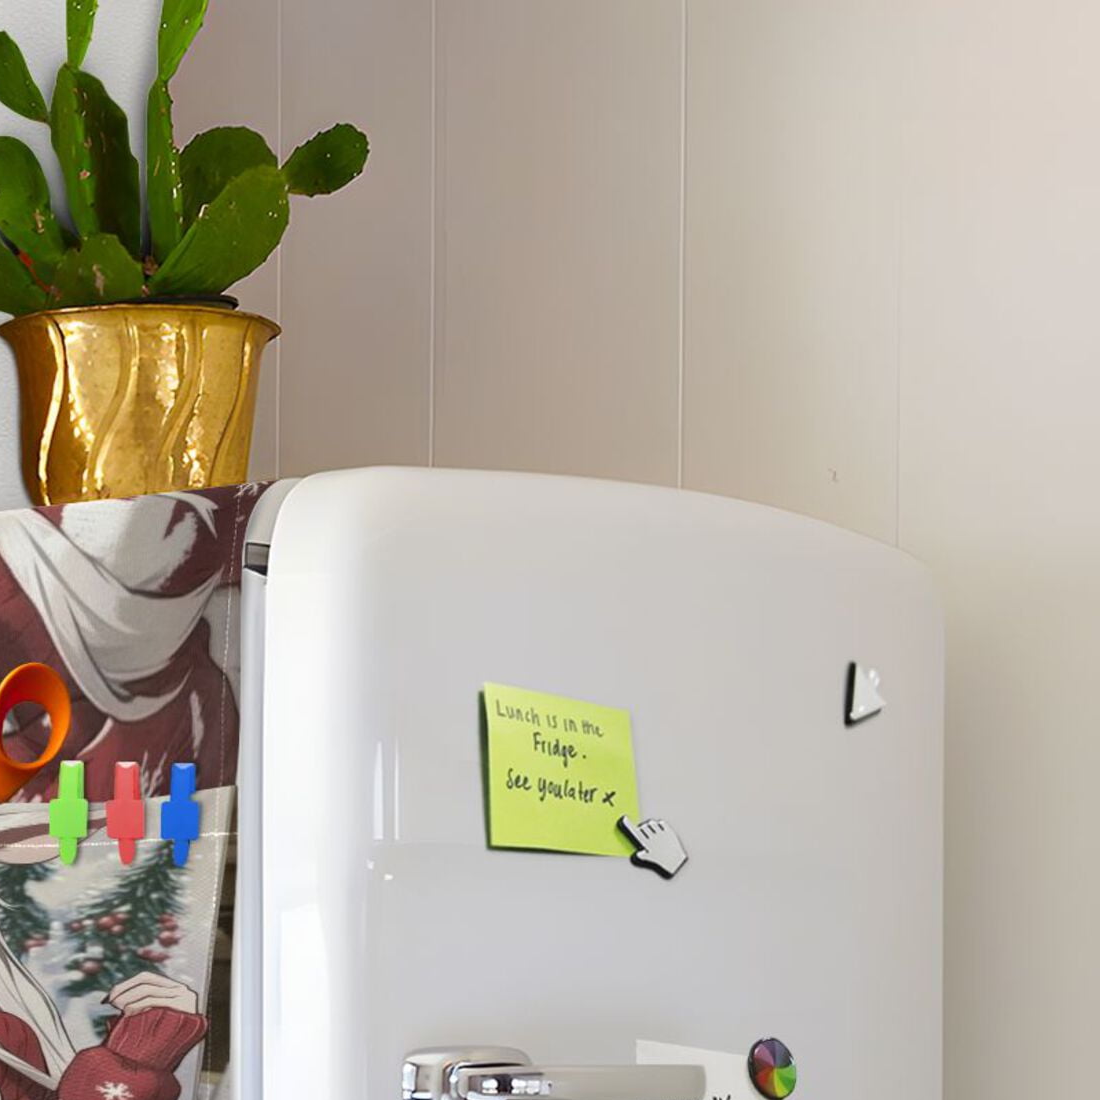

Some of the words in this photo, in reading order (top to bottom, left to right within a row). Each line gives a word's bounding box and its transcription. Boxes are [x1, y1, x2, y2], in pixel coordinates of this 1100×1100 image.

[495, 698, 540, 727] Lunch
[546, 713, 558, 729] is
[563, 718, 578, 733] in
[582, 719, 604, 738] the
[506, 767, 532, 791] See
